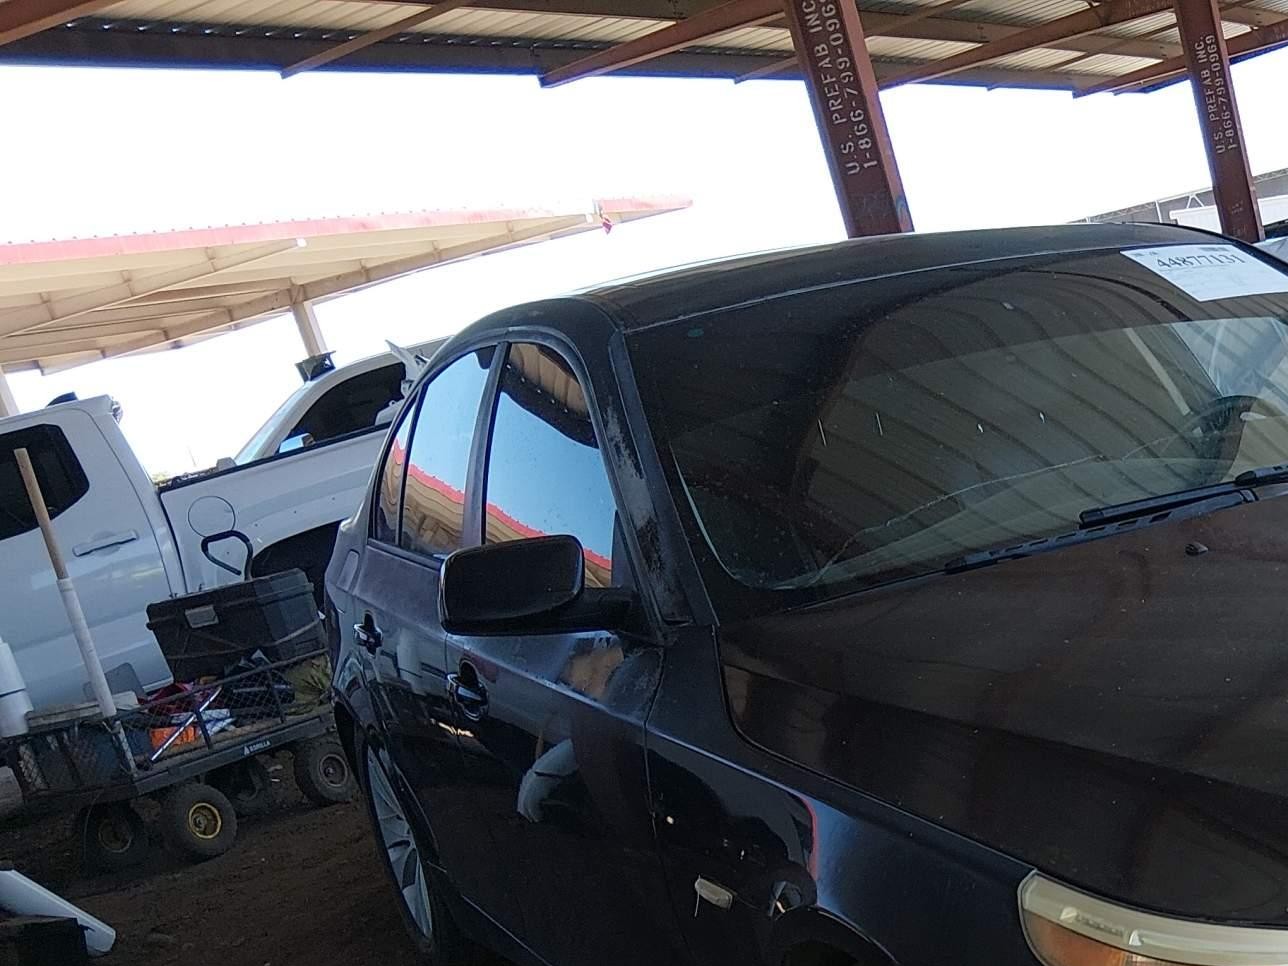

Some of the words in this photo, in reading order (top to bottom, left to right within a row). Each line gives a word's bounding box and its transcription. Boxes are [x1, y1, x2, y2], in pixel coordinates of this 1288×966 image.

[814, 44, 847, 125] PREFAB
[819, 0, 878, 169] 1-866-799-096
[1201, 70, 1220, 121] PREFAB
[841, 134, 860, 175] U.S.
[1156, 254, 1246, 269] 44877131
